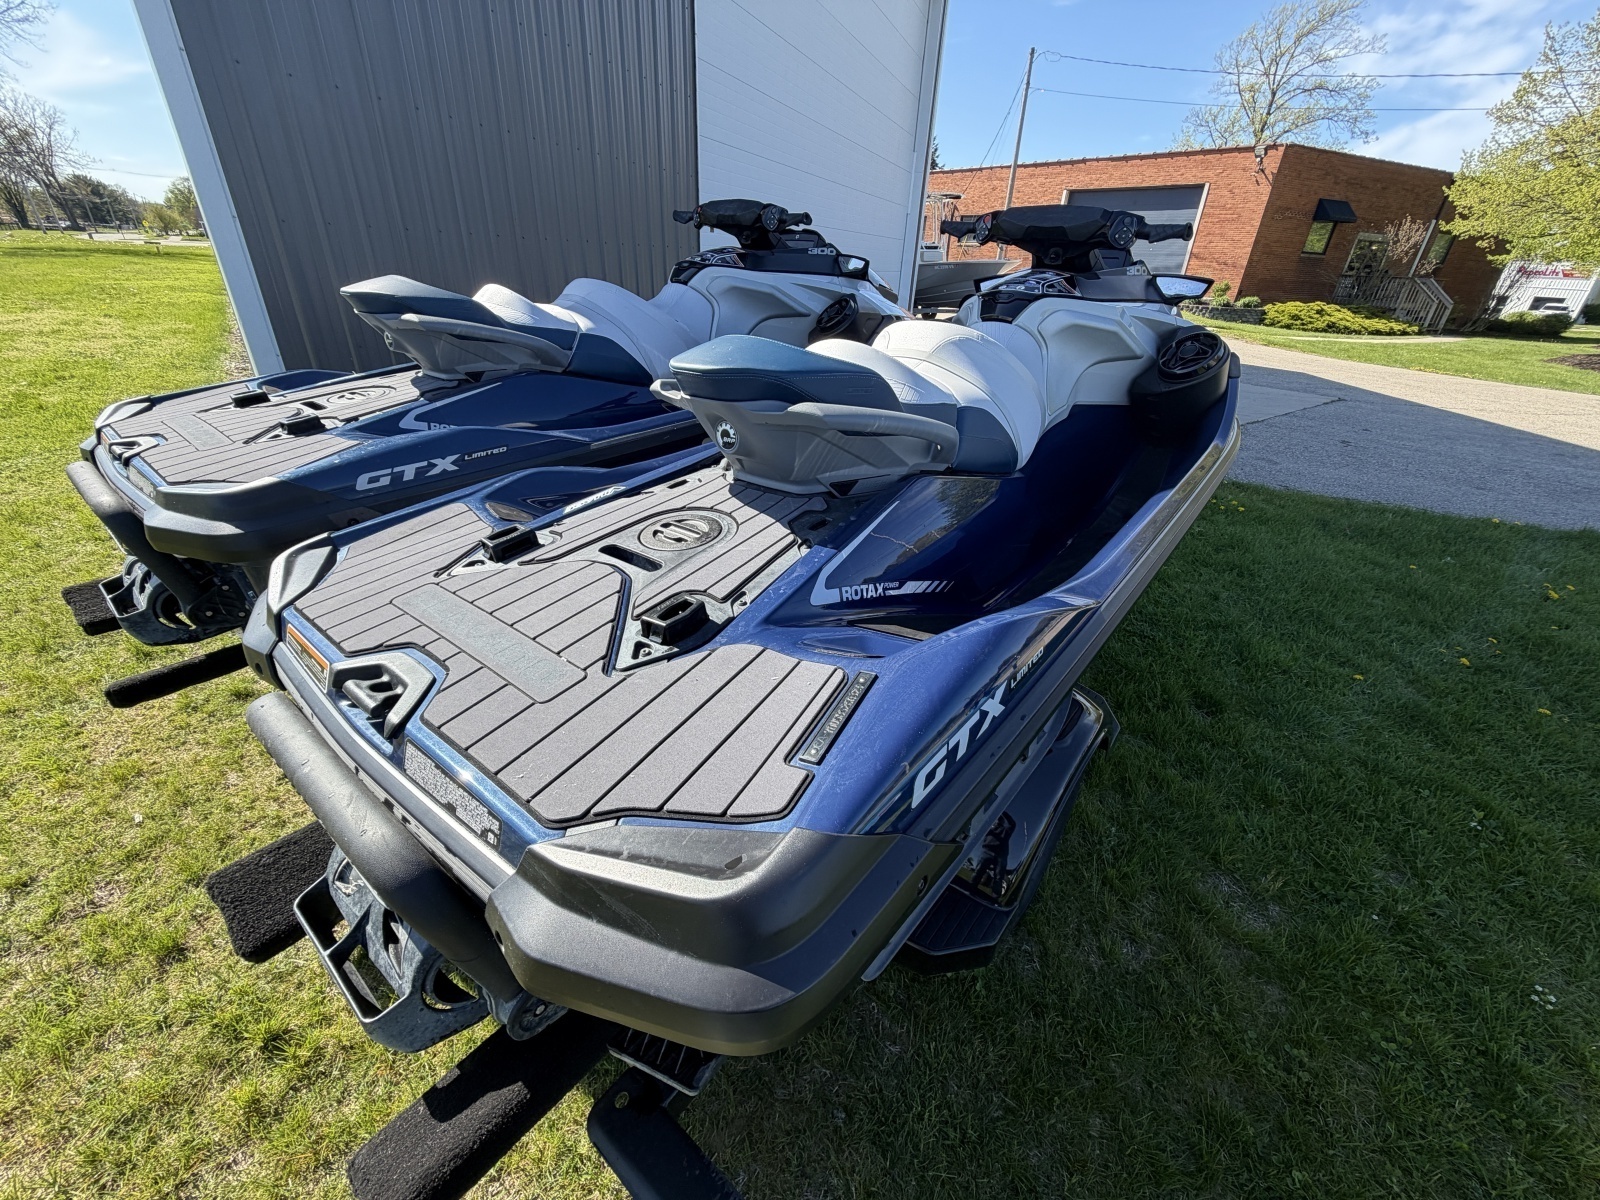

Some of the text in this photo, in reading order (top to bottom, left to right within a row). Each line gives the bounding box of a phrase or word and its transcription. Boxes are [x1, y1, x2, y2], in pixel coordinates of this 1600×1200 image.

[807, 247, 837, 256] 300
[1126, 265, 1148, 276] 300
[355, 446, 508, 491] GTX LIMITED
[841, 581, 900, 602] ROTAX POWER
[911, 646, 1044, 809] GTX LIMITED
